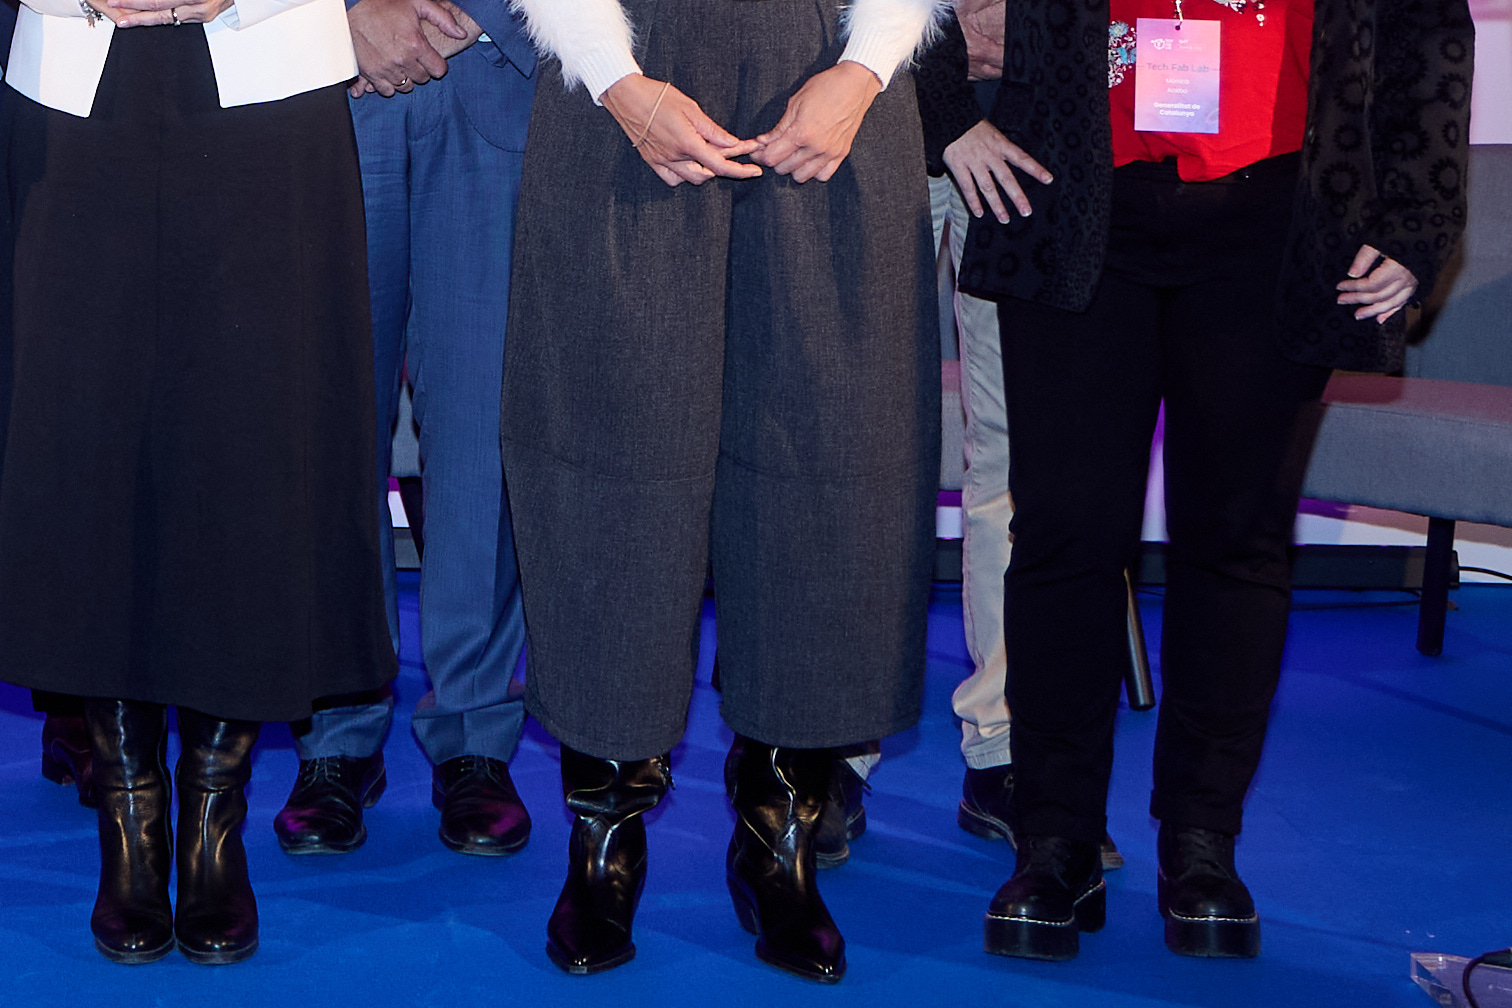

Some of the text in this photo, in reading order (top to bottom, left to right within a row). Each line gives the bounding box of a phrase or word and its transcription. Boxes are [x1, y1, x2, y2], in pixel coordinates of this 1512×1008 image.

[1147, 62, 1209, 73] Tech Fab Lab
